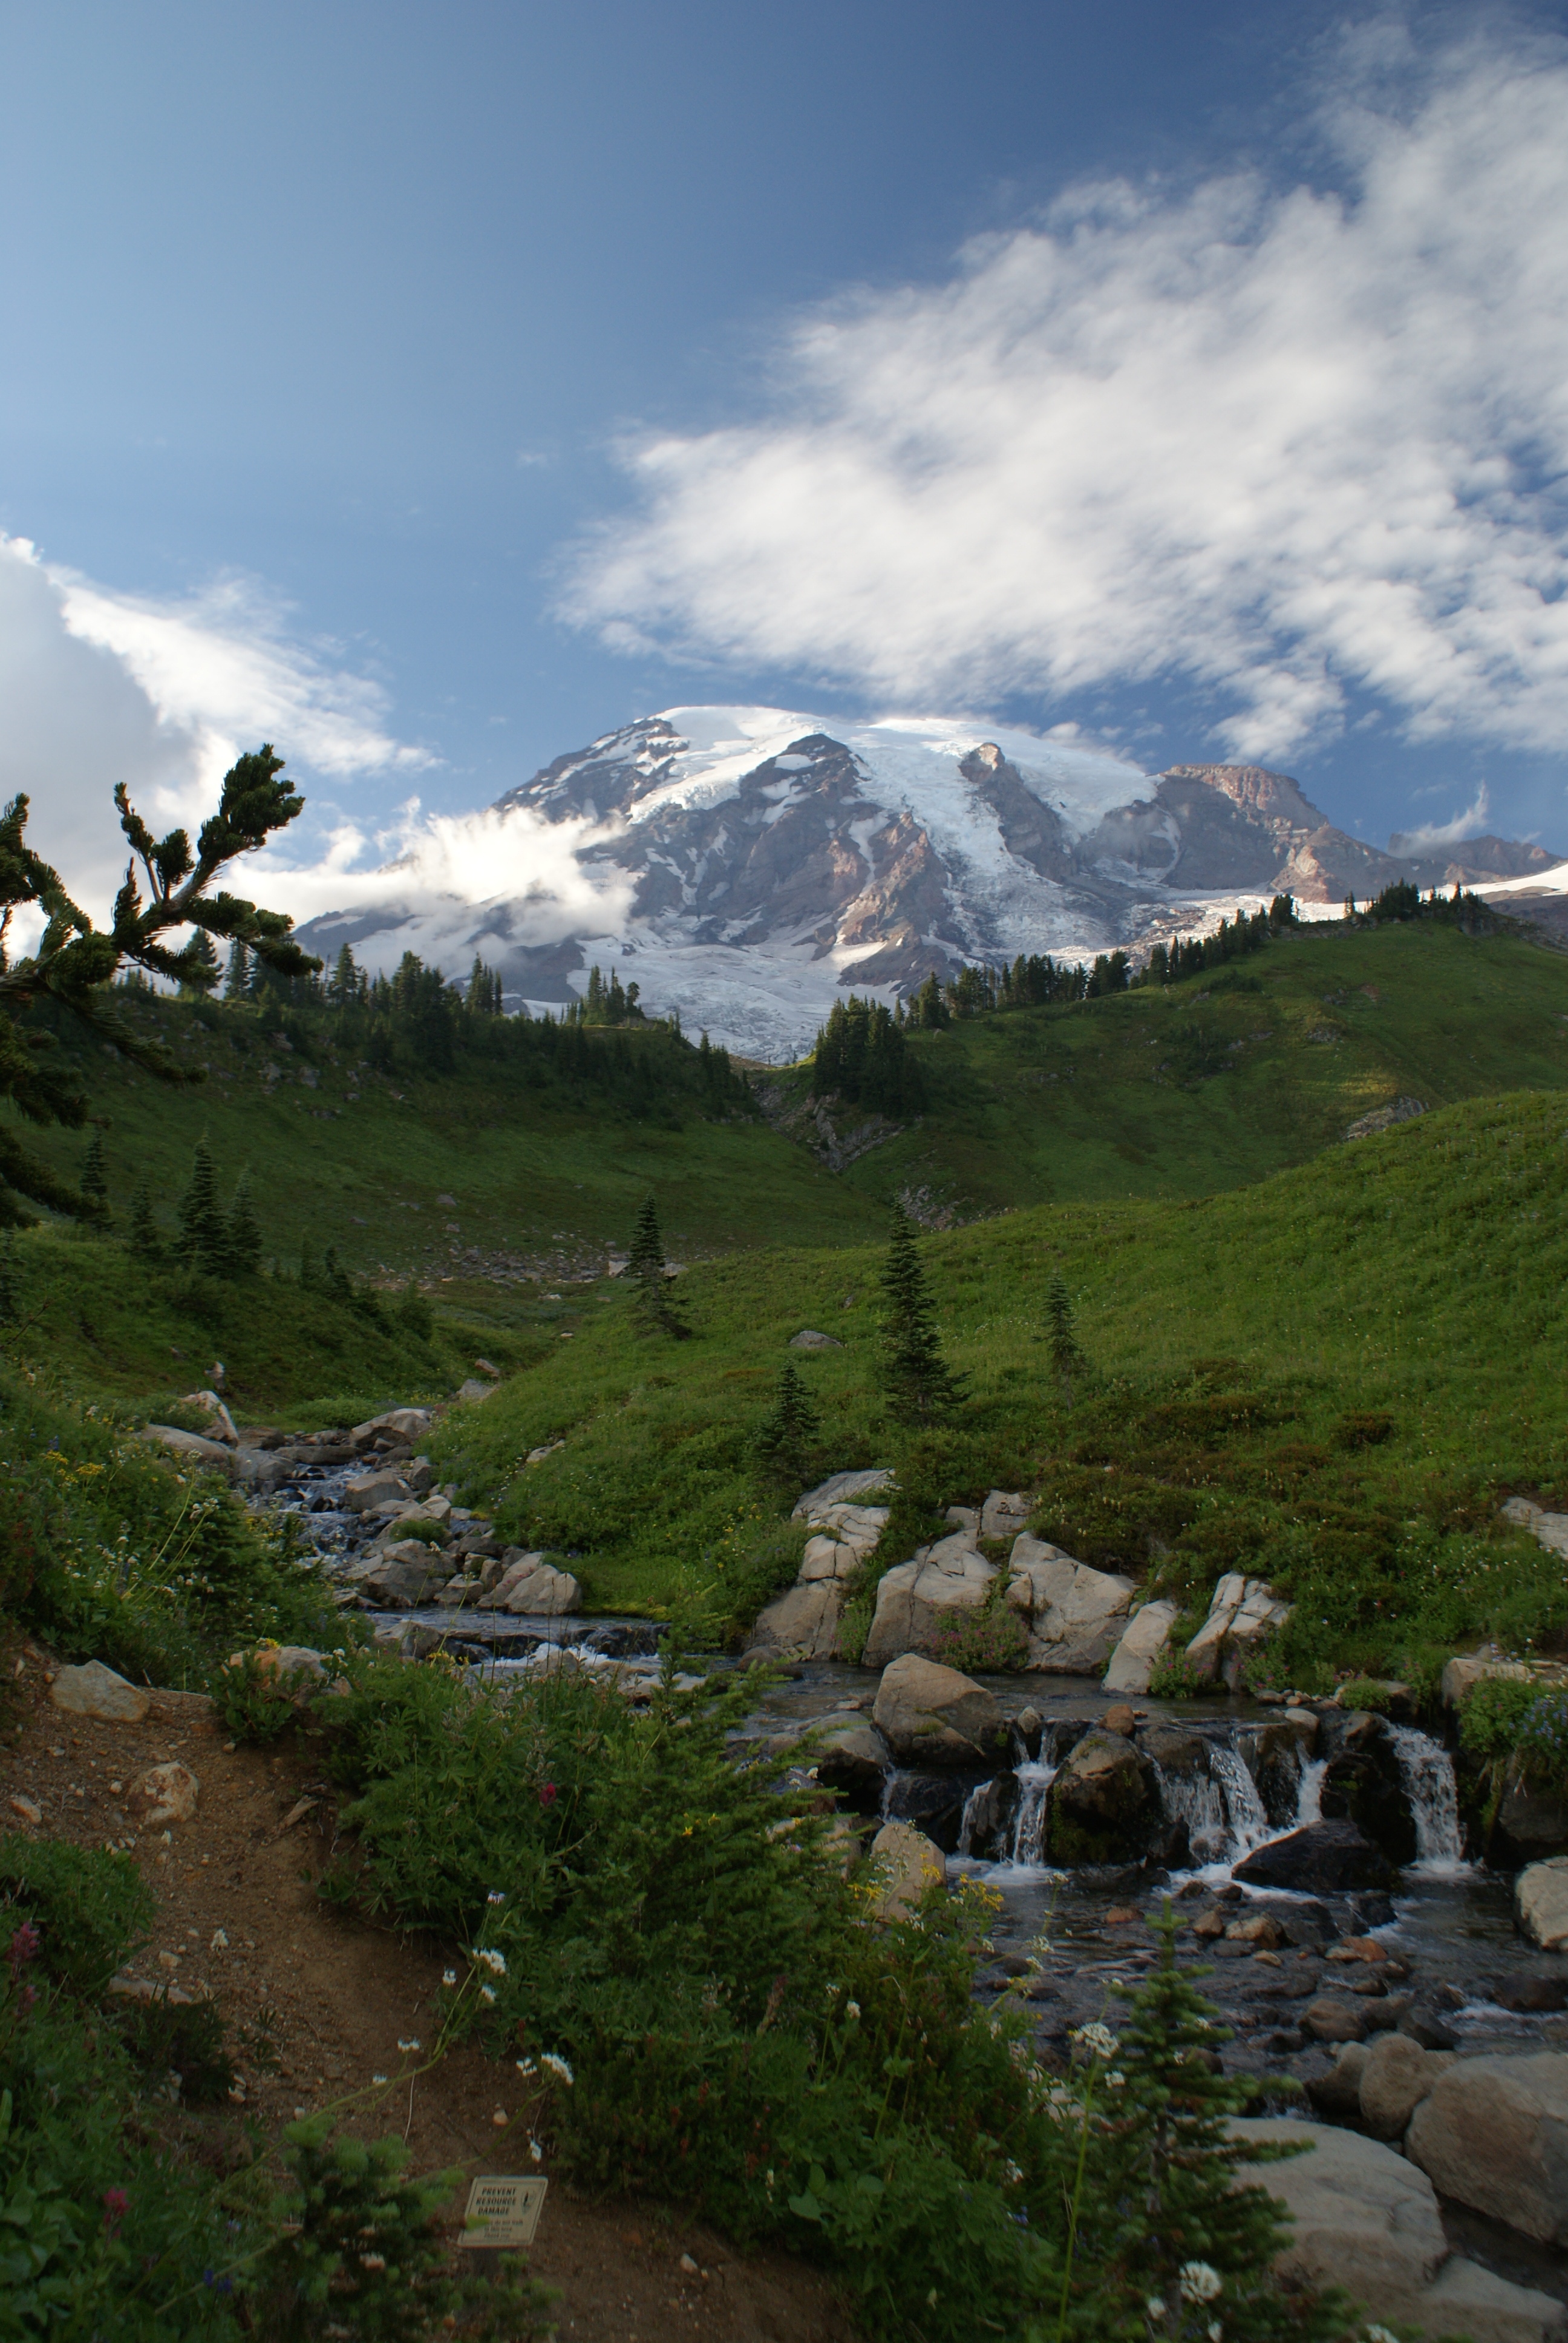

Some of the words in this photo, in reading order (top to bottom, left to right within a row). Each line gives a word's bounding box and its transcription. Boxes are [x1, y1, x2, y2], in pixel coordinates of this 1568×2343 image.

[482, 2186, 517, 2195] PREVENT
[476, 2197, 517, 2206] RESOURCE
[478, 2206, 510, 2215] DAMAGE
